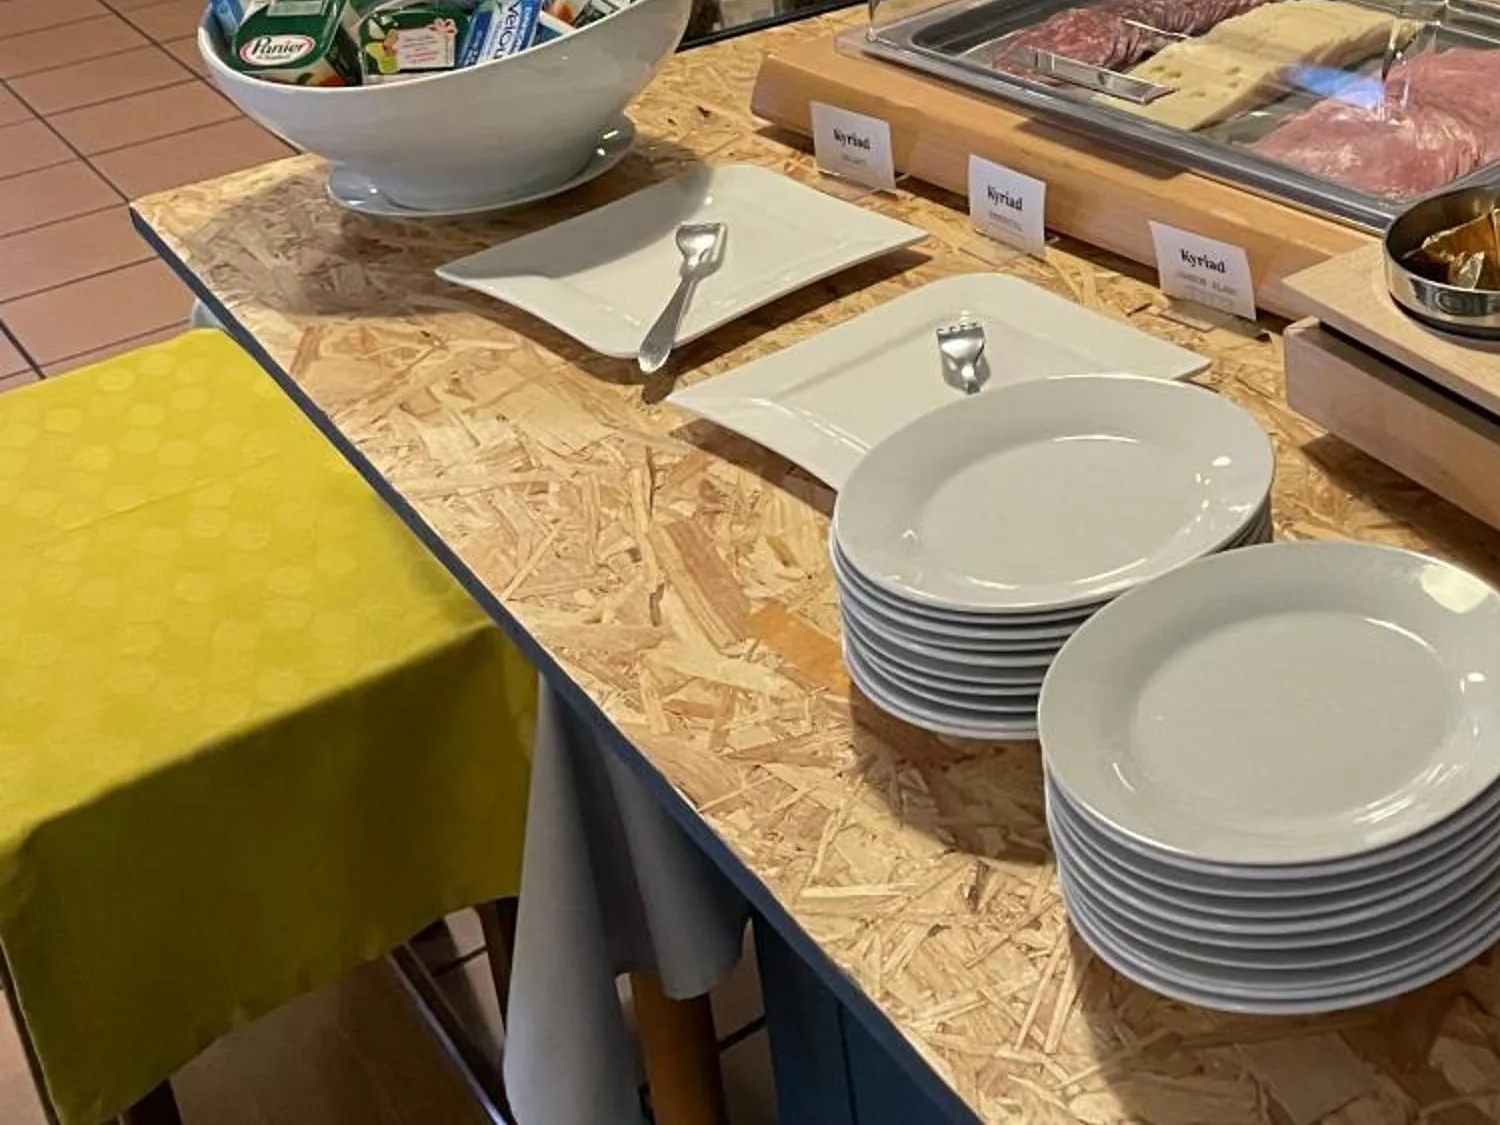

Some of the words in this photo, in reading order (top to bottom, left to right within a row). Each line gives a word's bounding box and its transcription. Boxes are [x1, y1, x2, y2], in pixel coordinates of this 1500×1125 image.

[832, 128, 871, 151] Kyriad
[986, 184, 1024, 212] Kyriad
[1179, 248, 1226, 274] Kyriad
